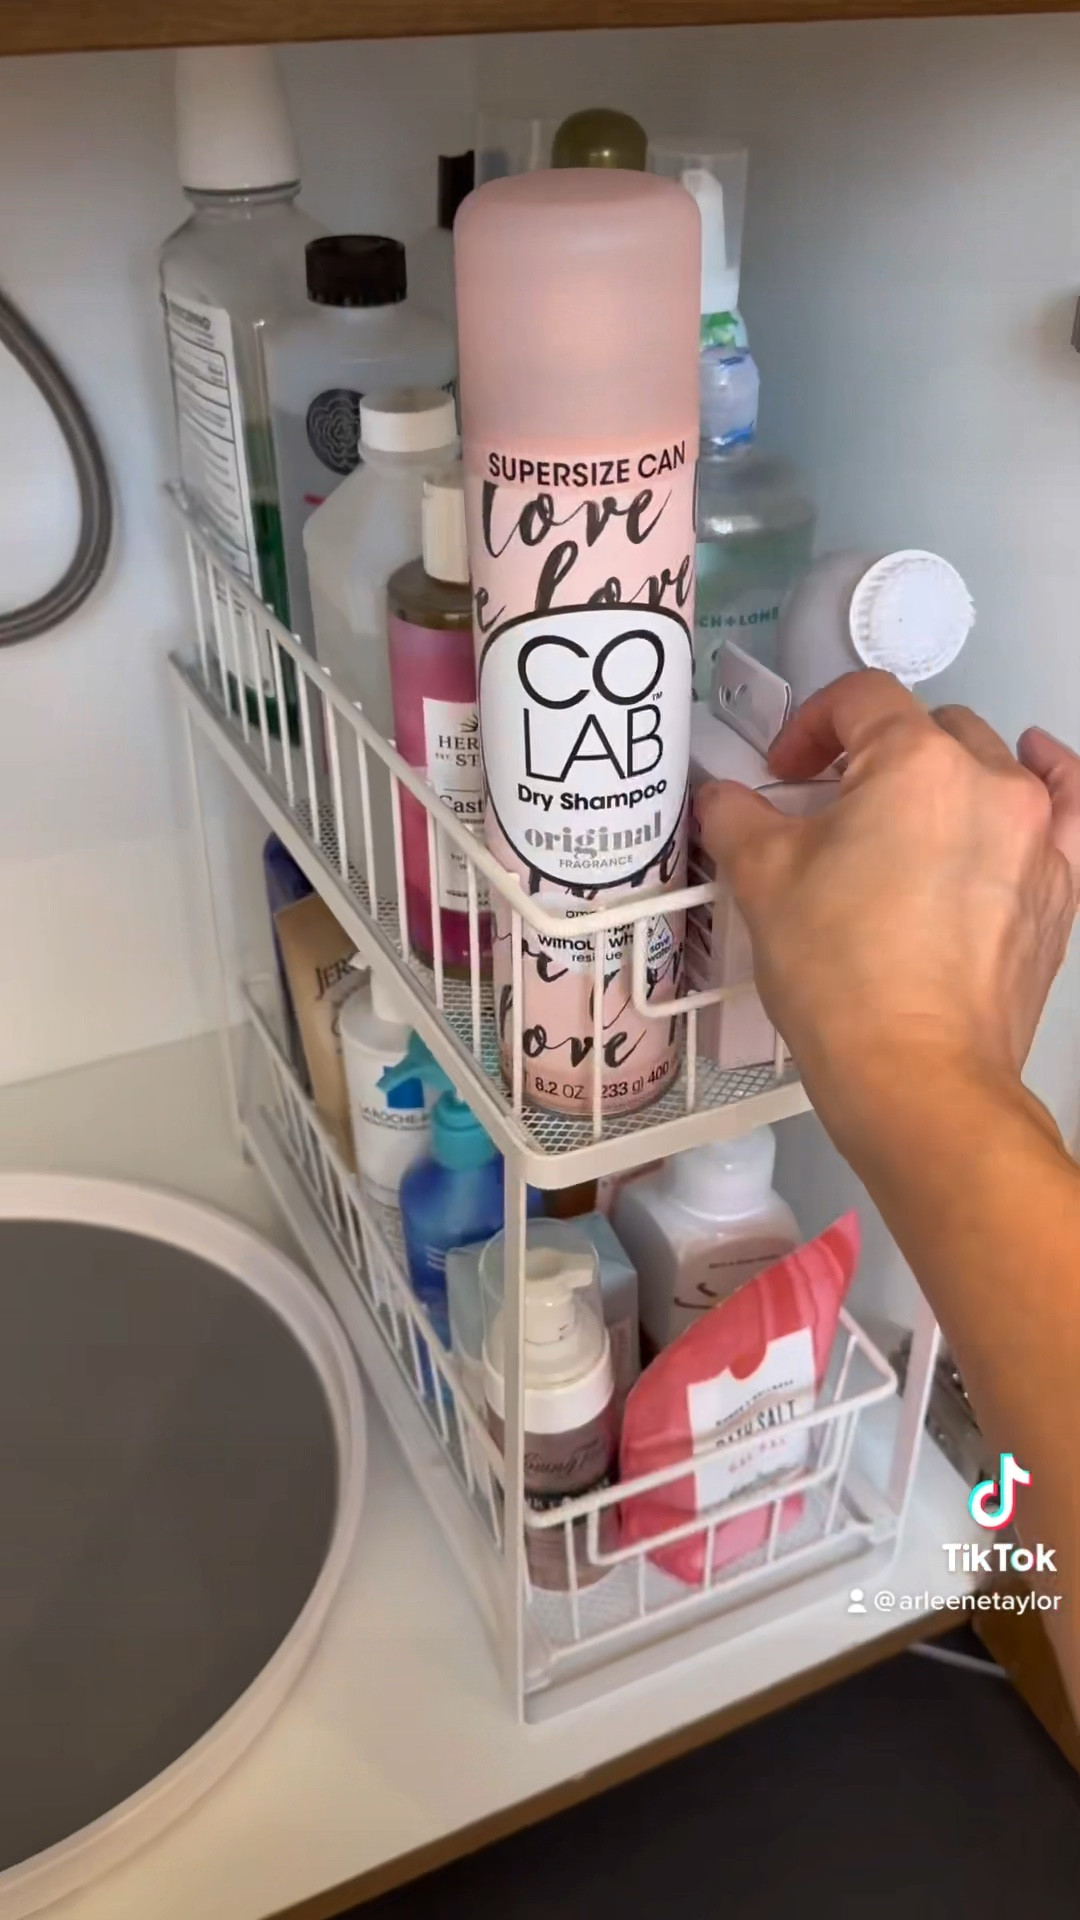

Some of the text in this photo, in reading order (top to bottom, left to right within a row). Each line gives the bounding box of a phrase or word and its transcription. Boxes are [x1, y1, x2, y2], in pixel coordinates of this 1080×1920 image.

[489, 440, 685, 487] SUPERSIZE CAN
[482, 480, 673, 558] love
[517, 629, 665, 710] CO
[523, 703, 664, 783] LAB
[517, 779, 668, 811] Dry Shampoo
[524, 810, 661, 860] original
[559, 855, 633, 869] FRAGRANCE
[572, 951, 623, 963] resiue
[535, 1076, 560, 1097] 8.2
[562, 1084, 586, 1100] OZ
